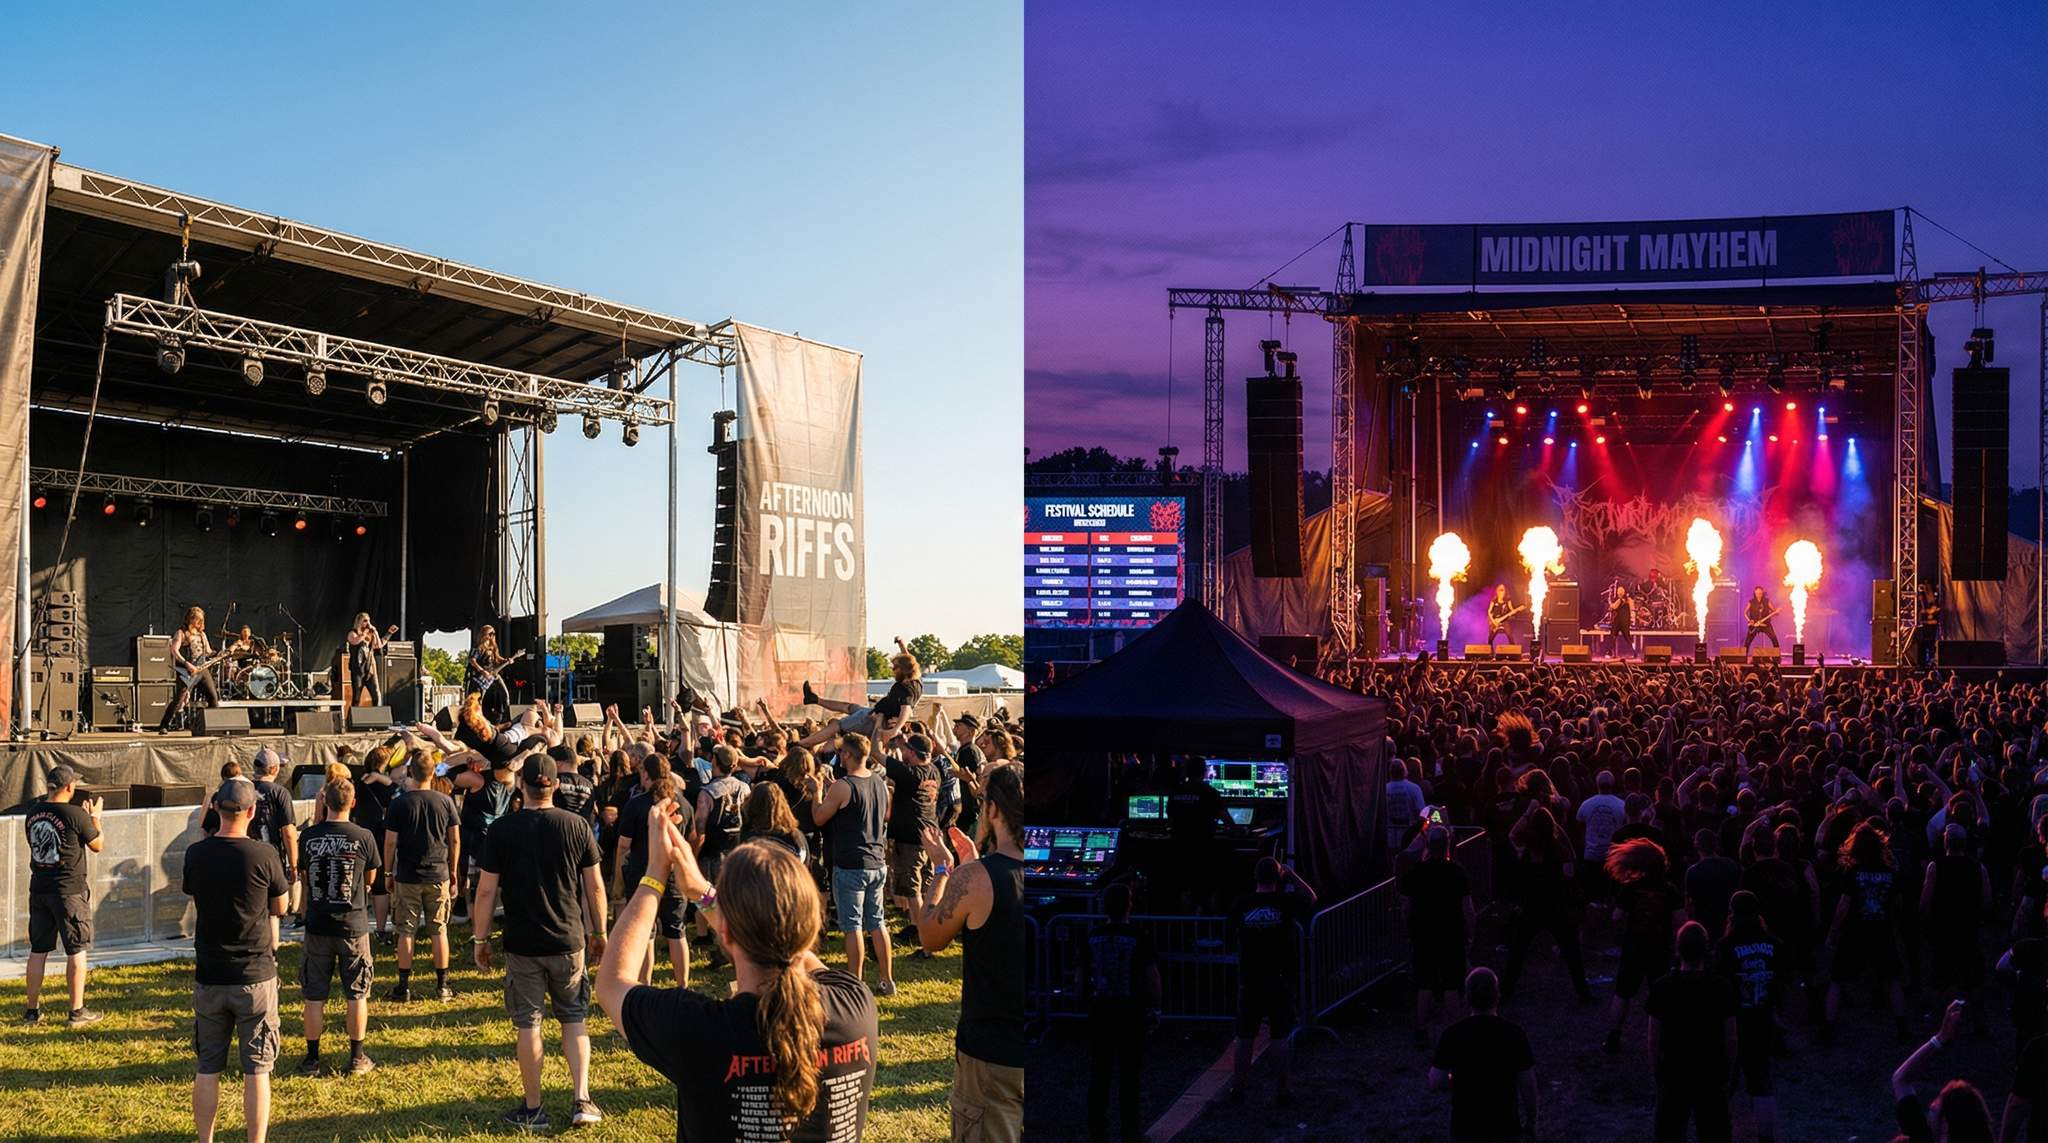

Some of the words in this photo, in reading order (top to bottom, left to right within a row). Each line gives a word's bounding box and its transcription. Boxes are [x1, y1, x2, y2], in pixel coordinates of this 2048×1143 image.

[1481, 235, 1629, 272] MIDNIGHT
[1639, 230, 1777, 270] MAYHEM
[760, 481, 854, 519] AFTERNOON
[1045, 504, 1087, 517] FESTIVAL
[1088, 504, 1135, 517] SCHEDULE
[759, 513, 855, 582] RIFFS
[832, 1035, 872, 1065] RIFFS
